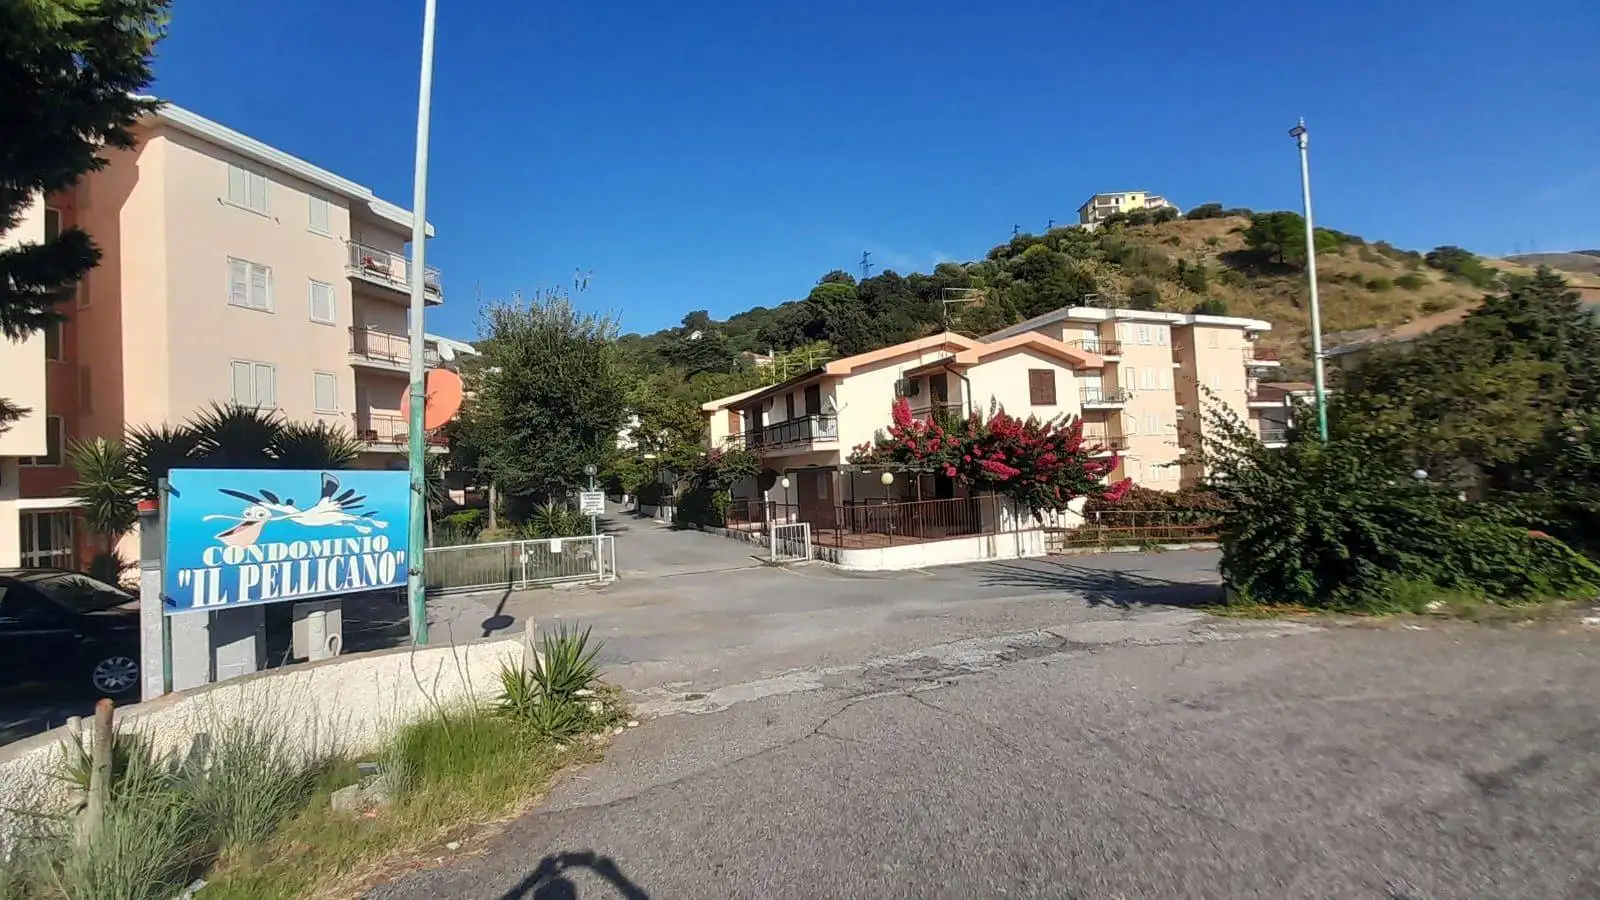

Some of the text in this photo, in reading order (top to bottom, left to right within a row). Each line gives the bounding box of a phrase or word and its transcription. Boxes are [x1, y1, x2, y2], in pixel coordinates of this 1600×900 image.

[203, 535, 388, 566] CONDOMINIO
[178, 551, 404, 608] "IL PELLICANO"
